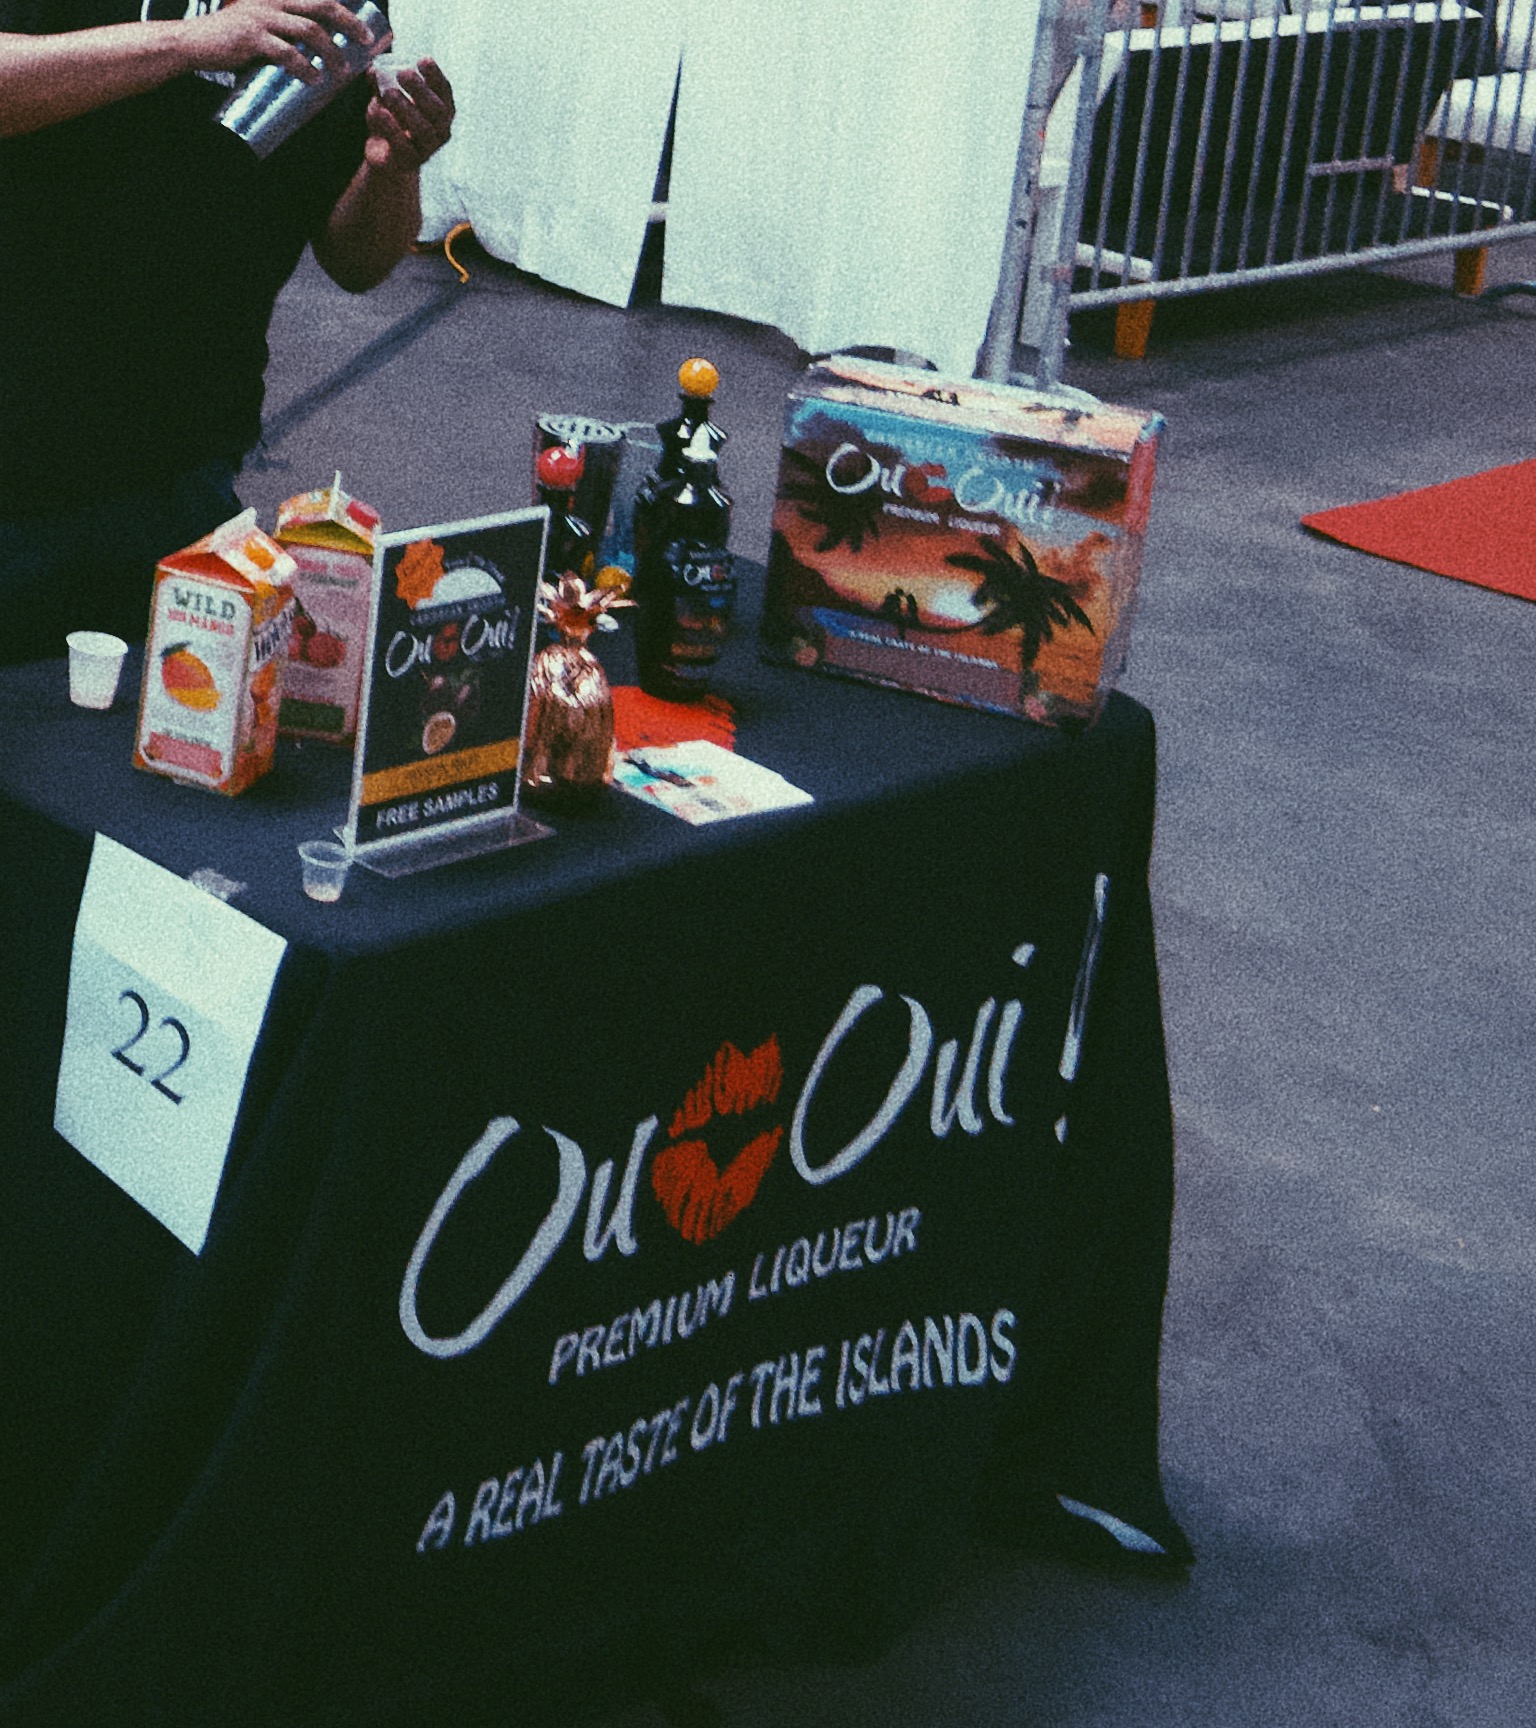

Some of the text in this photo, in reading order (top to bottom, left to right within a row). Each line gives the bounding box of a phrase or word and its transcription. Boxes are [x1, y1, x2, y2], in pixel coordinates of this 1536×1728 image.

[826, 441, 906, 498] Ou
[174, 587, 236, 620] WILD
[385, 631, 433, 678] Ou
[376, 782, 499, 830] FREE SAMPLES
[110, 989, 191, 1105] 22
[398, 1114, 658, 1359] Ou
[548, 1206, 922, 1384] PREMIUM LIQUEUR
[416, 1307, 1017, 1553] A REAL TASTE OF THE ISLANDS
